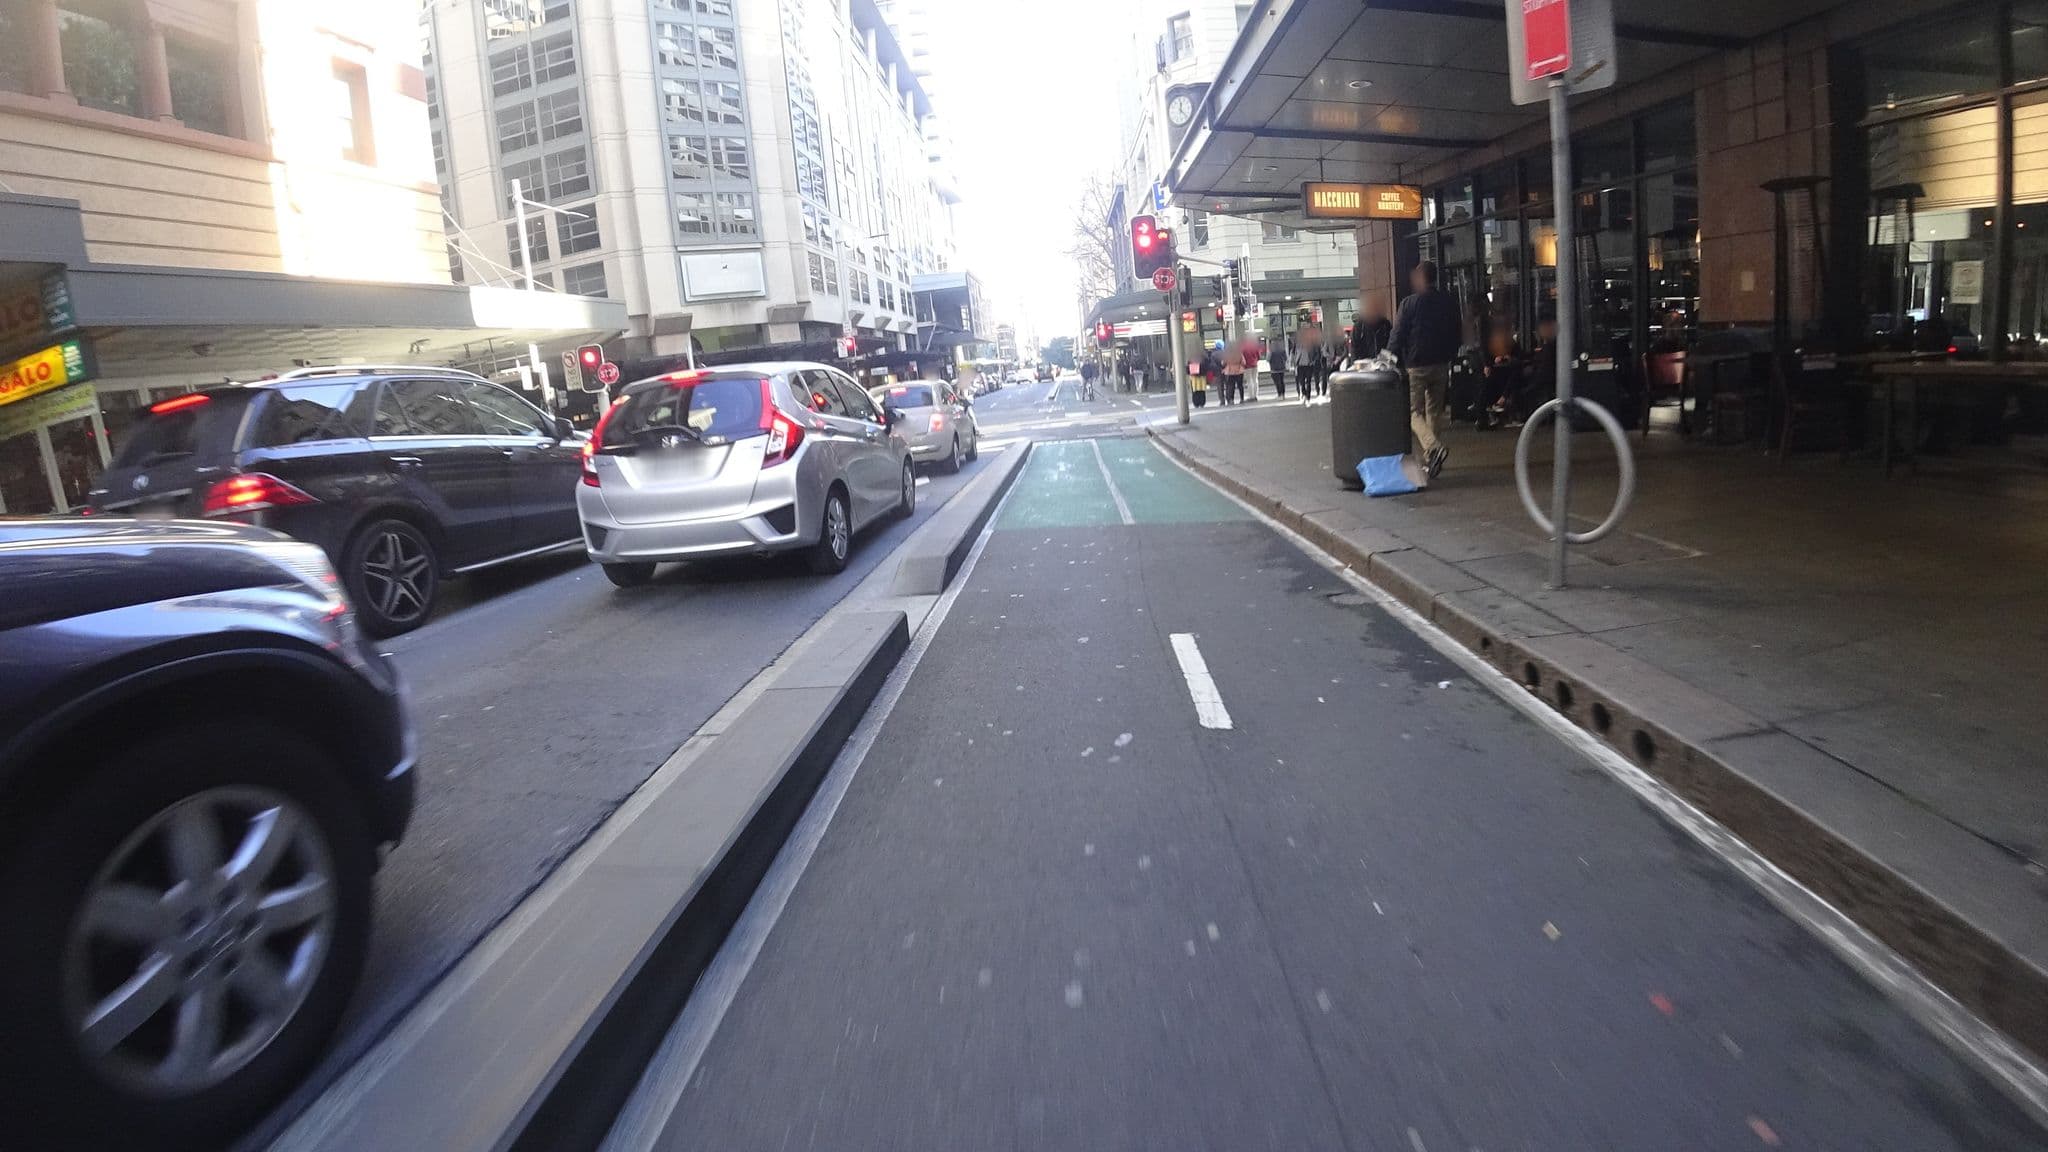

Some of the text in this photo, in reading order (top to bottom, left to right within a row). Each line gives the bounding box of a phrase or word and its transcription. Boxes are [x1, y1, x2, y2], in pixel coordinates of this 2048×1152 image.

[1314, 191, 1360, 208] MACCHIATO
[1155, 274, 1174, 285] STOP
[599, 367, 619, 379] STOP
